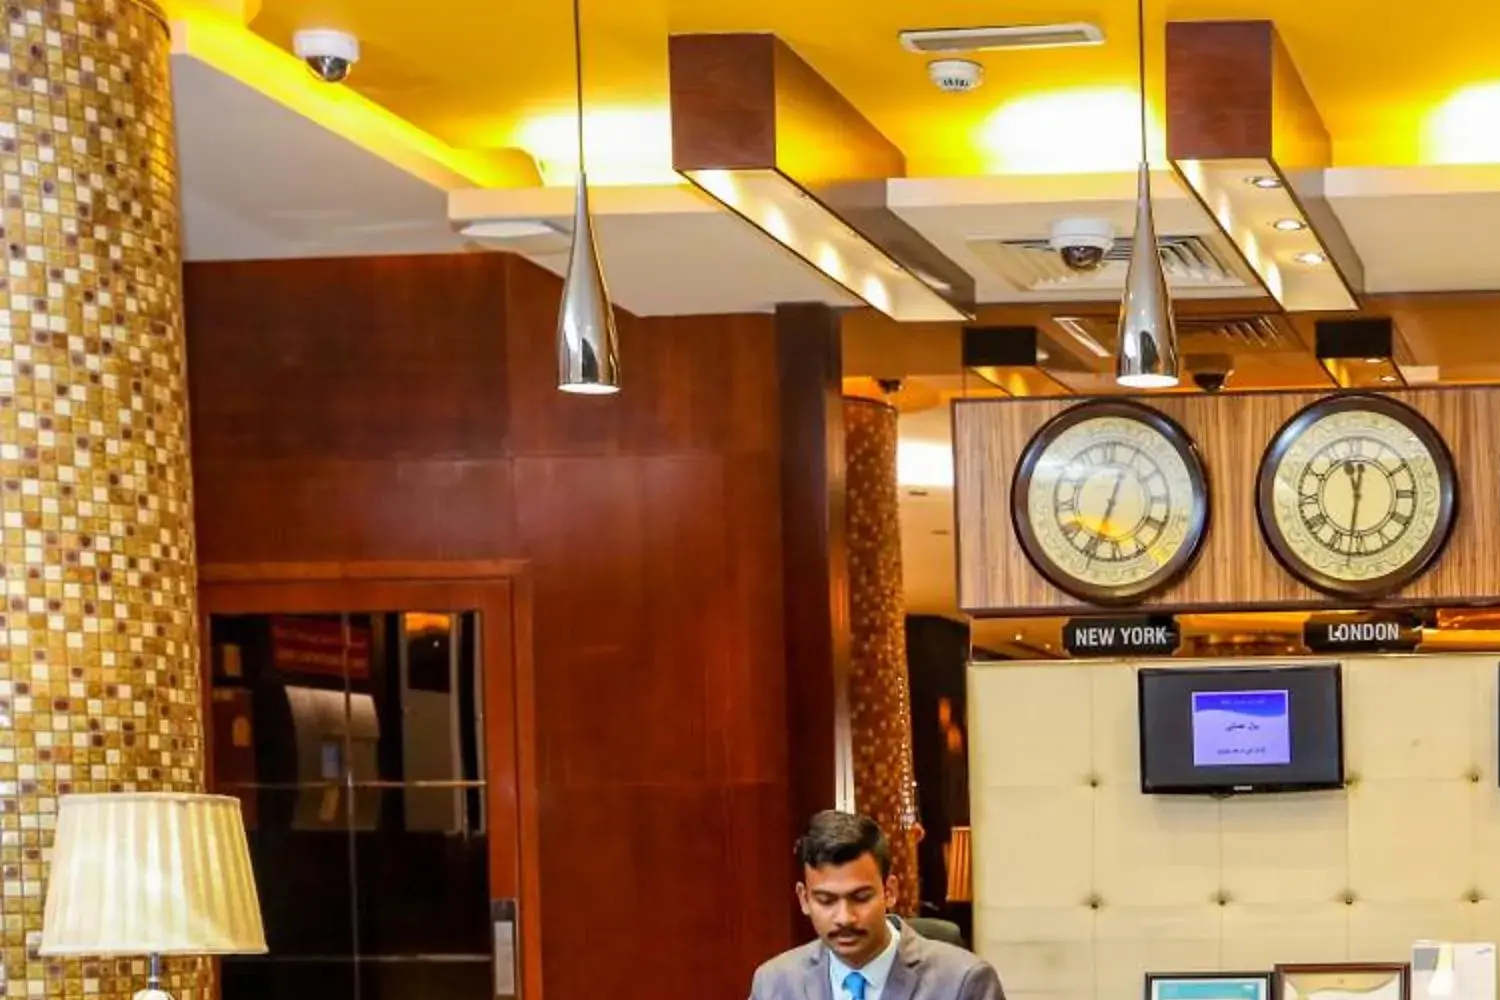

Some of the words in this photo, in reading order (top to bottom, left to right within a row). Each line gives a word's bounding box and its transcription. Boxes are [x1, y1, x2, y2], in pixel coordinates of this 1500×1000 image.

[1075, 626, 1115, 646] NEW
[1120, 626, 1167, 645] YORK
[1328, 623, 1399, 641] LONDON
